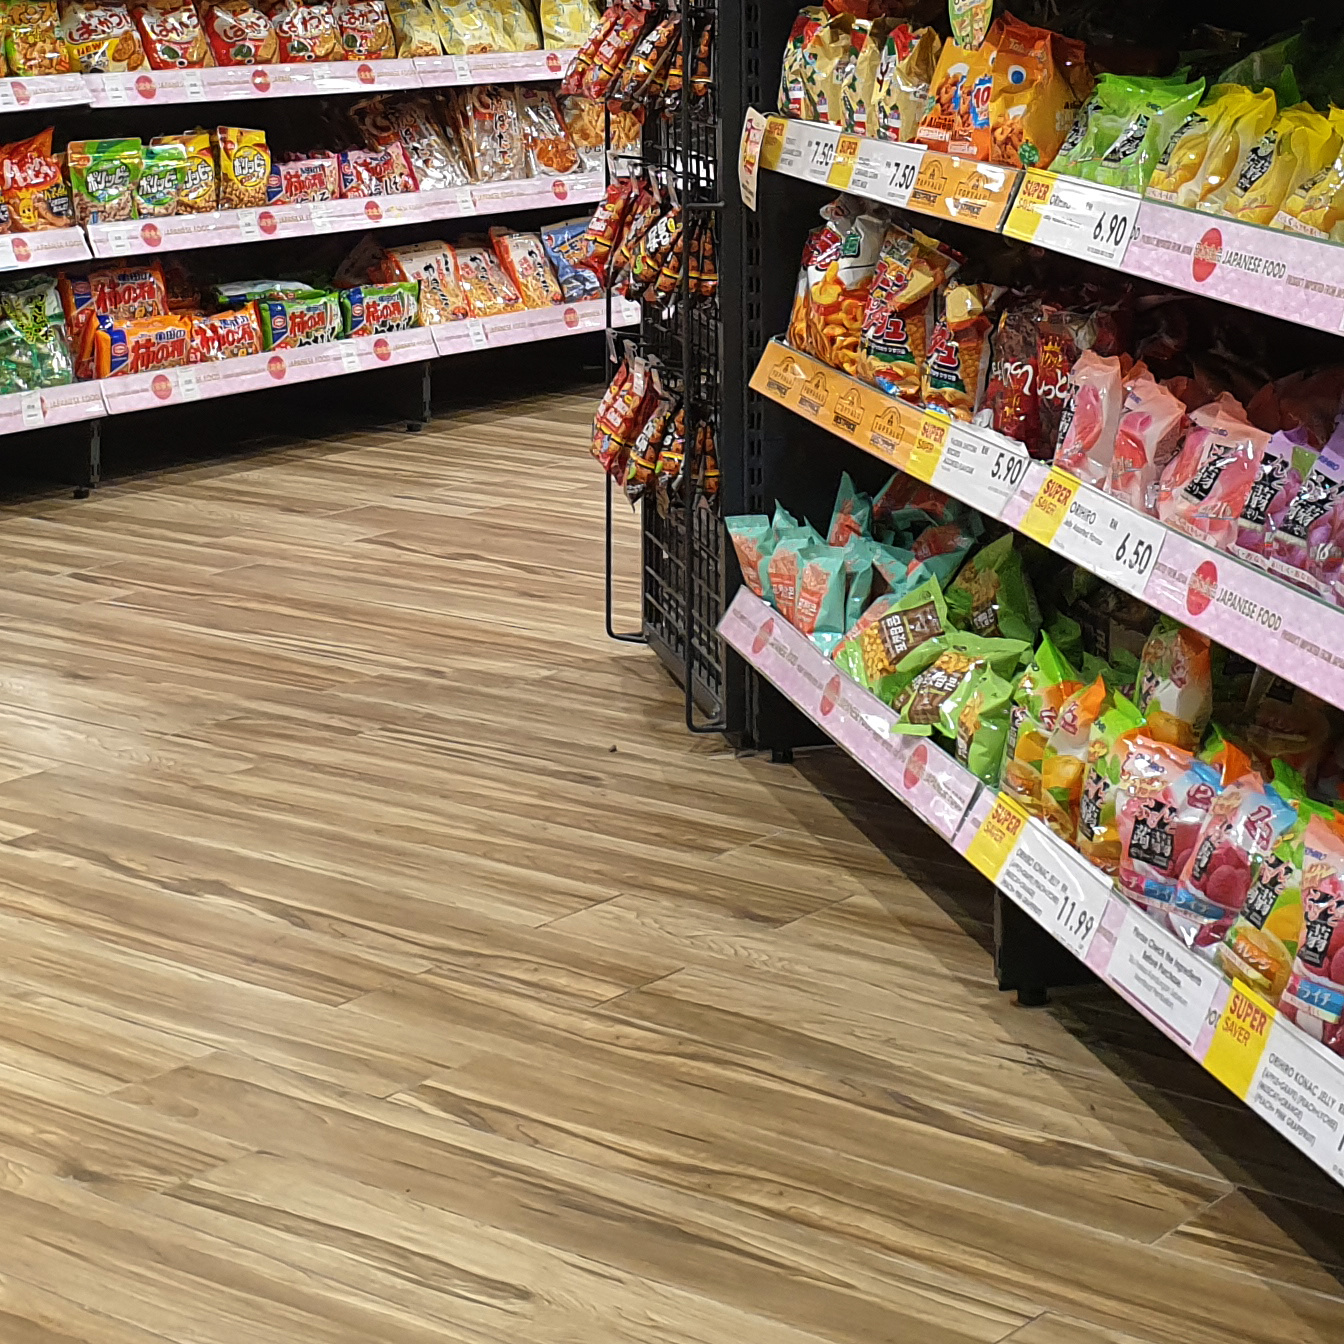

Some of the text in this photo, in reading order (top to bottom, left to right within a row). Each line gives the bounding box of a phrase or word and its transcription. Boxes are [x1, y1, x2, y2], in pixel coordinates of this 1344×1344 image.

[887, 162, 915, 190] 7.50
[1092, 212, 1128, 248] 6.90
[991, 455, 1022, 485] 5.90
[1068, 501, 1097, 526] ORIHIRO
[1114, 532, 1155, 575] 6.50
[1216, 586, 1283, 633] JAPANESE FOOD
[1055, 895, 1095, 939] 11.99
[1222, 1018, 1252, 1047] SAVER
[1229, 993, 1268, 1037] SUPER
[1317, 1088, 1337, 1109] JELLY
